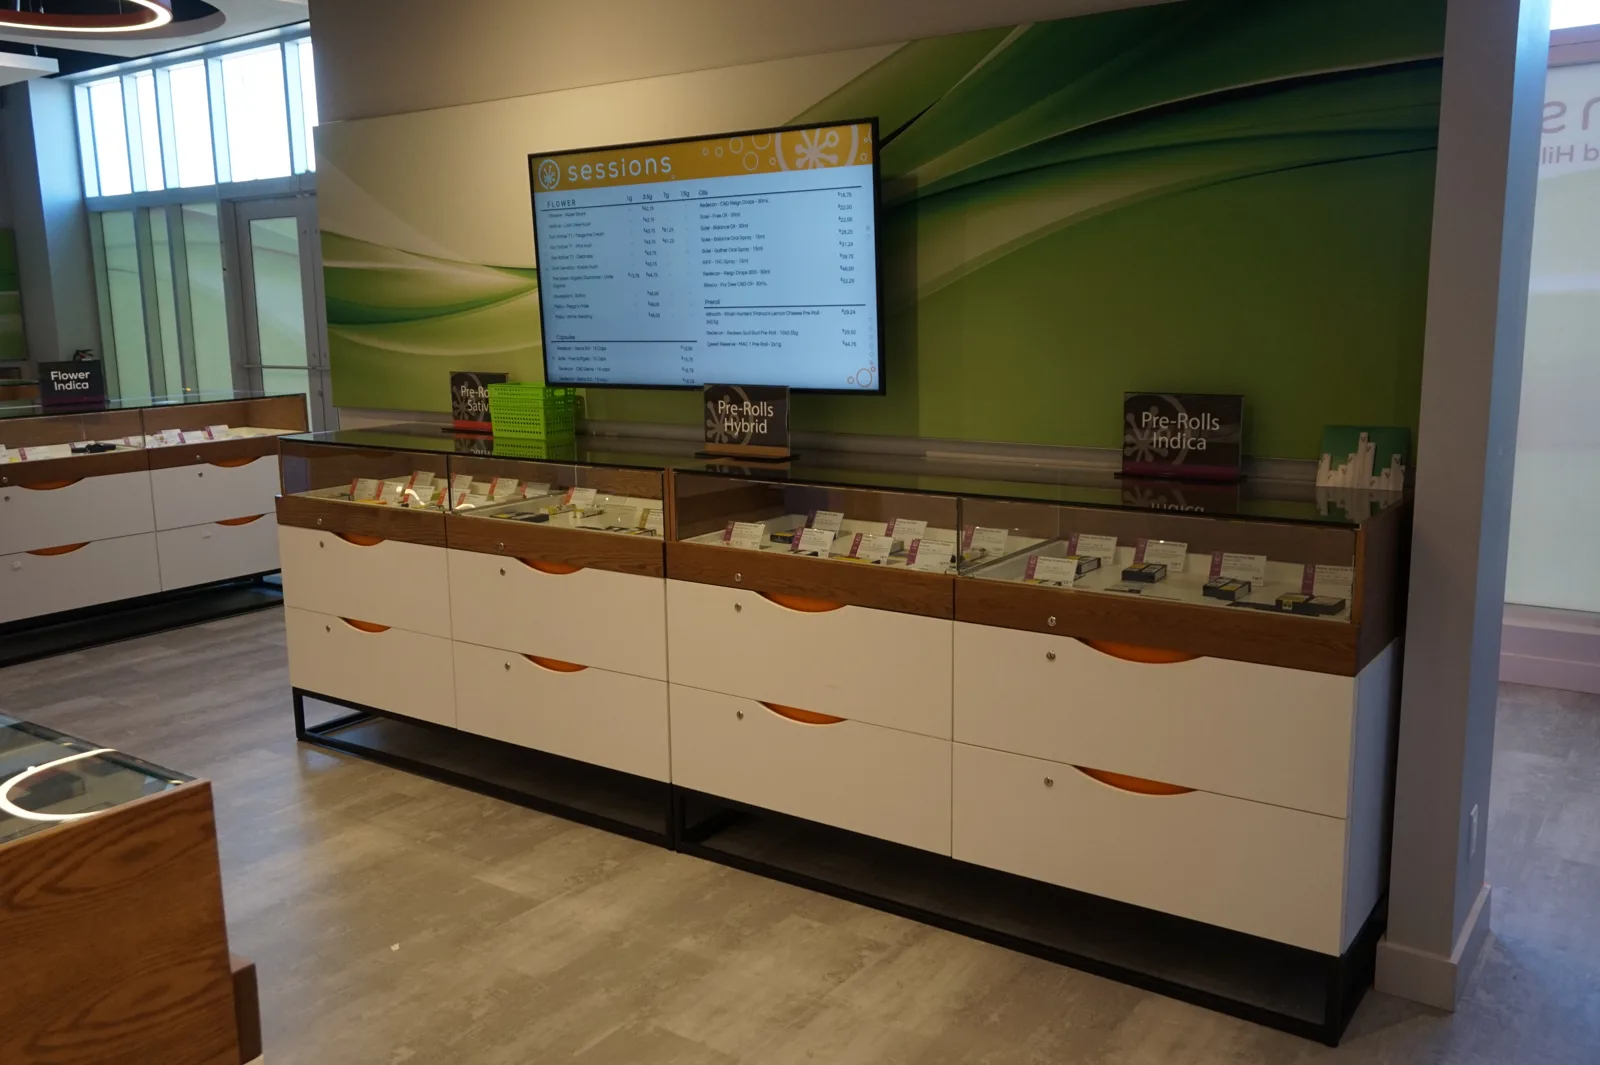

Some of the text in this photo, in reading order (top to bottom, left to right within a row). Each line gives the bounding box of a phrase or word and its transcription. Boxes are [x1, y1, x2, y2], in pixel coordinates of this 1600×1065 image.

[568, 156, 672, 182] sessions
[642, 193, 653, 201] 3.5g
[681, 190, 690, 198] 15g
[547, 199, 576, 208] FLOWER
[50, 370, 91, 381] Flower
[54, 380, 89, 391] Indica
[460, 385, 490, 399] Pre-Ro
[467, 399, 490, 412] Sativ
[718, 399, 774, 417] Pre-Rolls
[724, 417, 768, 436] Hybrid
[1141, 411, 1220, 431] Pre-Rolls
[1152, 431, 1207, 451] Indica
